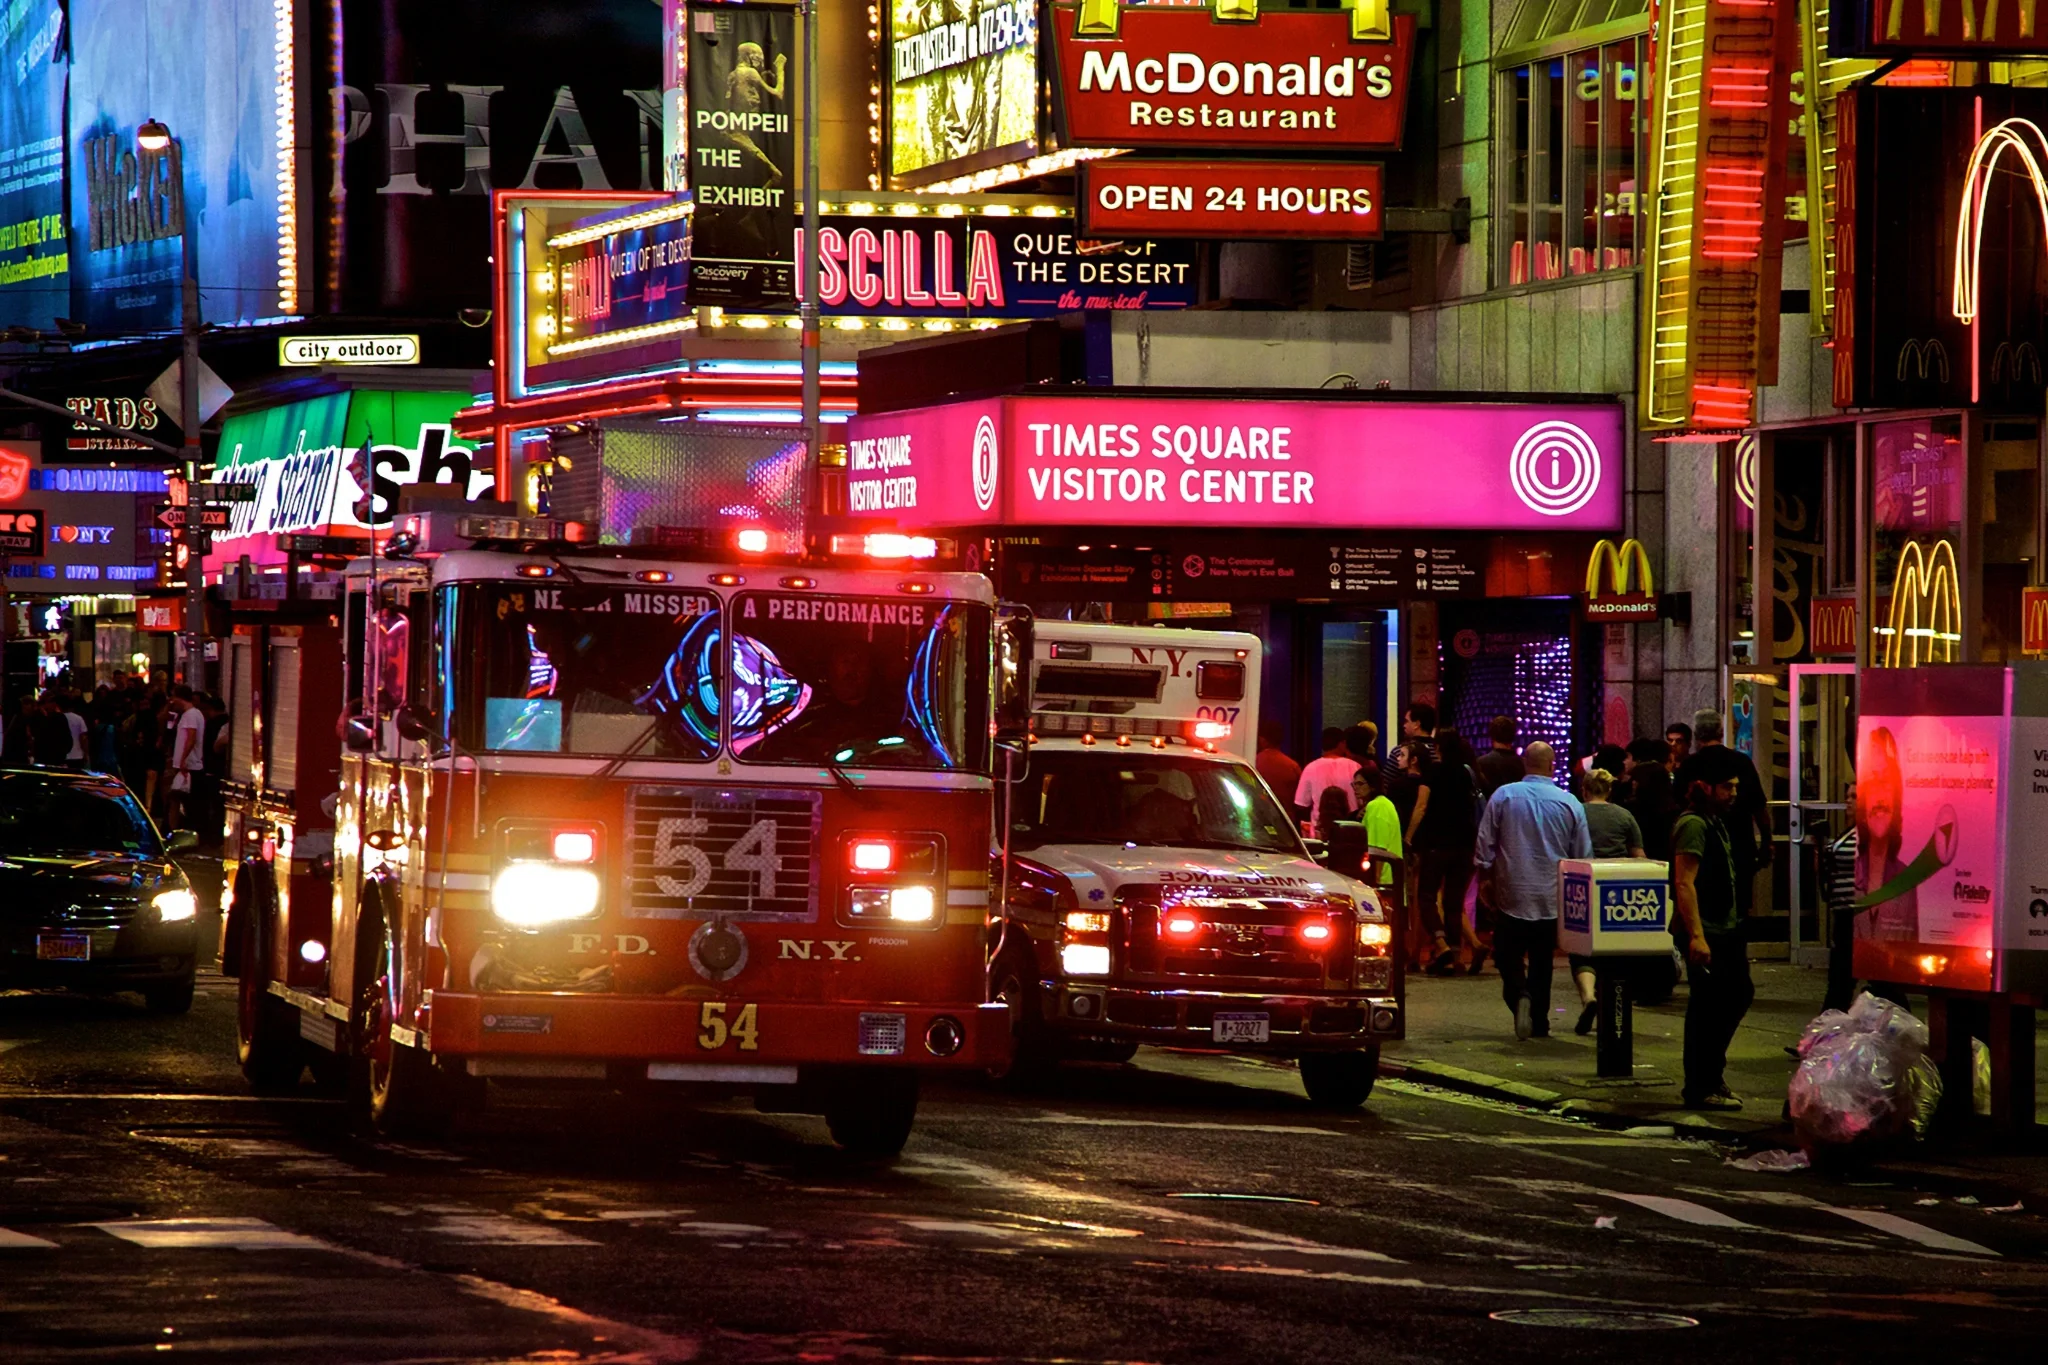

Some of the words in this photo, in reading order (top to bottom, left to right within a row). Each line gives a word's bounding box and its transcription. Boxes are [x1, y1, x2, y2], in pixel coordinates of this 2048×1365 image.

[1079, 50, 1393, 99] McDonald's
[696, 111, 788, 133] POMPEII
[1129, 101, 1337, 130] Restaurant
[698, 148, 741, 168] THE
[699, 185, 785, 208] EXHIBIT
[1099, 185, 1193, 211] OPEN
[1205, 188, 1246, 211] 24
[1257, 187, 1372, 214] HOURS
[610, 250, 637, 281] QUEEN
[638, 246, 652, 271] OF
[653, 242, 667, 268] THE
[697, 265, 748, 280] Discovery
[1013, 262, 1065, 283] THE
[1080, 263, 1190, 284] DESERT
[1058, 289, 1084, 309] the
[298, 341, 329, 360] city
[338, 341, 403, 357] outdoor
[66, 397, 159, 430] TADS
[850, 440, 874, 471] TIMES
[877, 433, 912, 472] SQUARE
[1028, 424, 1140, 457] TIMES
[1152, 425, 1291, 465] SQUARE
[229, 485, 241, 499] 47
[850, 484, 882, 511] VISITOR
[883, 476, 917, 509] CENTER
[1028, 468, 1166, 502] VISITOR
[1179, 470, 1315, 504] CENTER
[51, 525, 60, 543] I
[77, 525, 114, 543] NY
[1210, 568, 1228, 576] New
[1260, 568, 1275, 576] Eve
[625, 594, 709, 616] MISSED
[743, 598, 757, 618] A
[768, 602, 923, 625] PERFORMANCE
[1588, 603, 1656, 613] McDonald's
[44, 638, 61, 654] 10
[653, 818, 783, 900] 54
[1572, 884, 1586, 902] USA
[1623, 889, 1659, 905] USA
[1963, 884, 1991, 904] Fidelity
[1566, 901, 1587, 920] TODAY
[1604, 905, 1661, 921] TODAY
[568, 934, 656, 956] F.D.
[778, 939, 862, 961] N.Y.
[699, 1003, 758, 1050] 54
